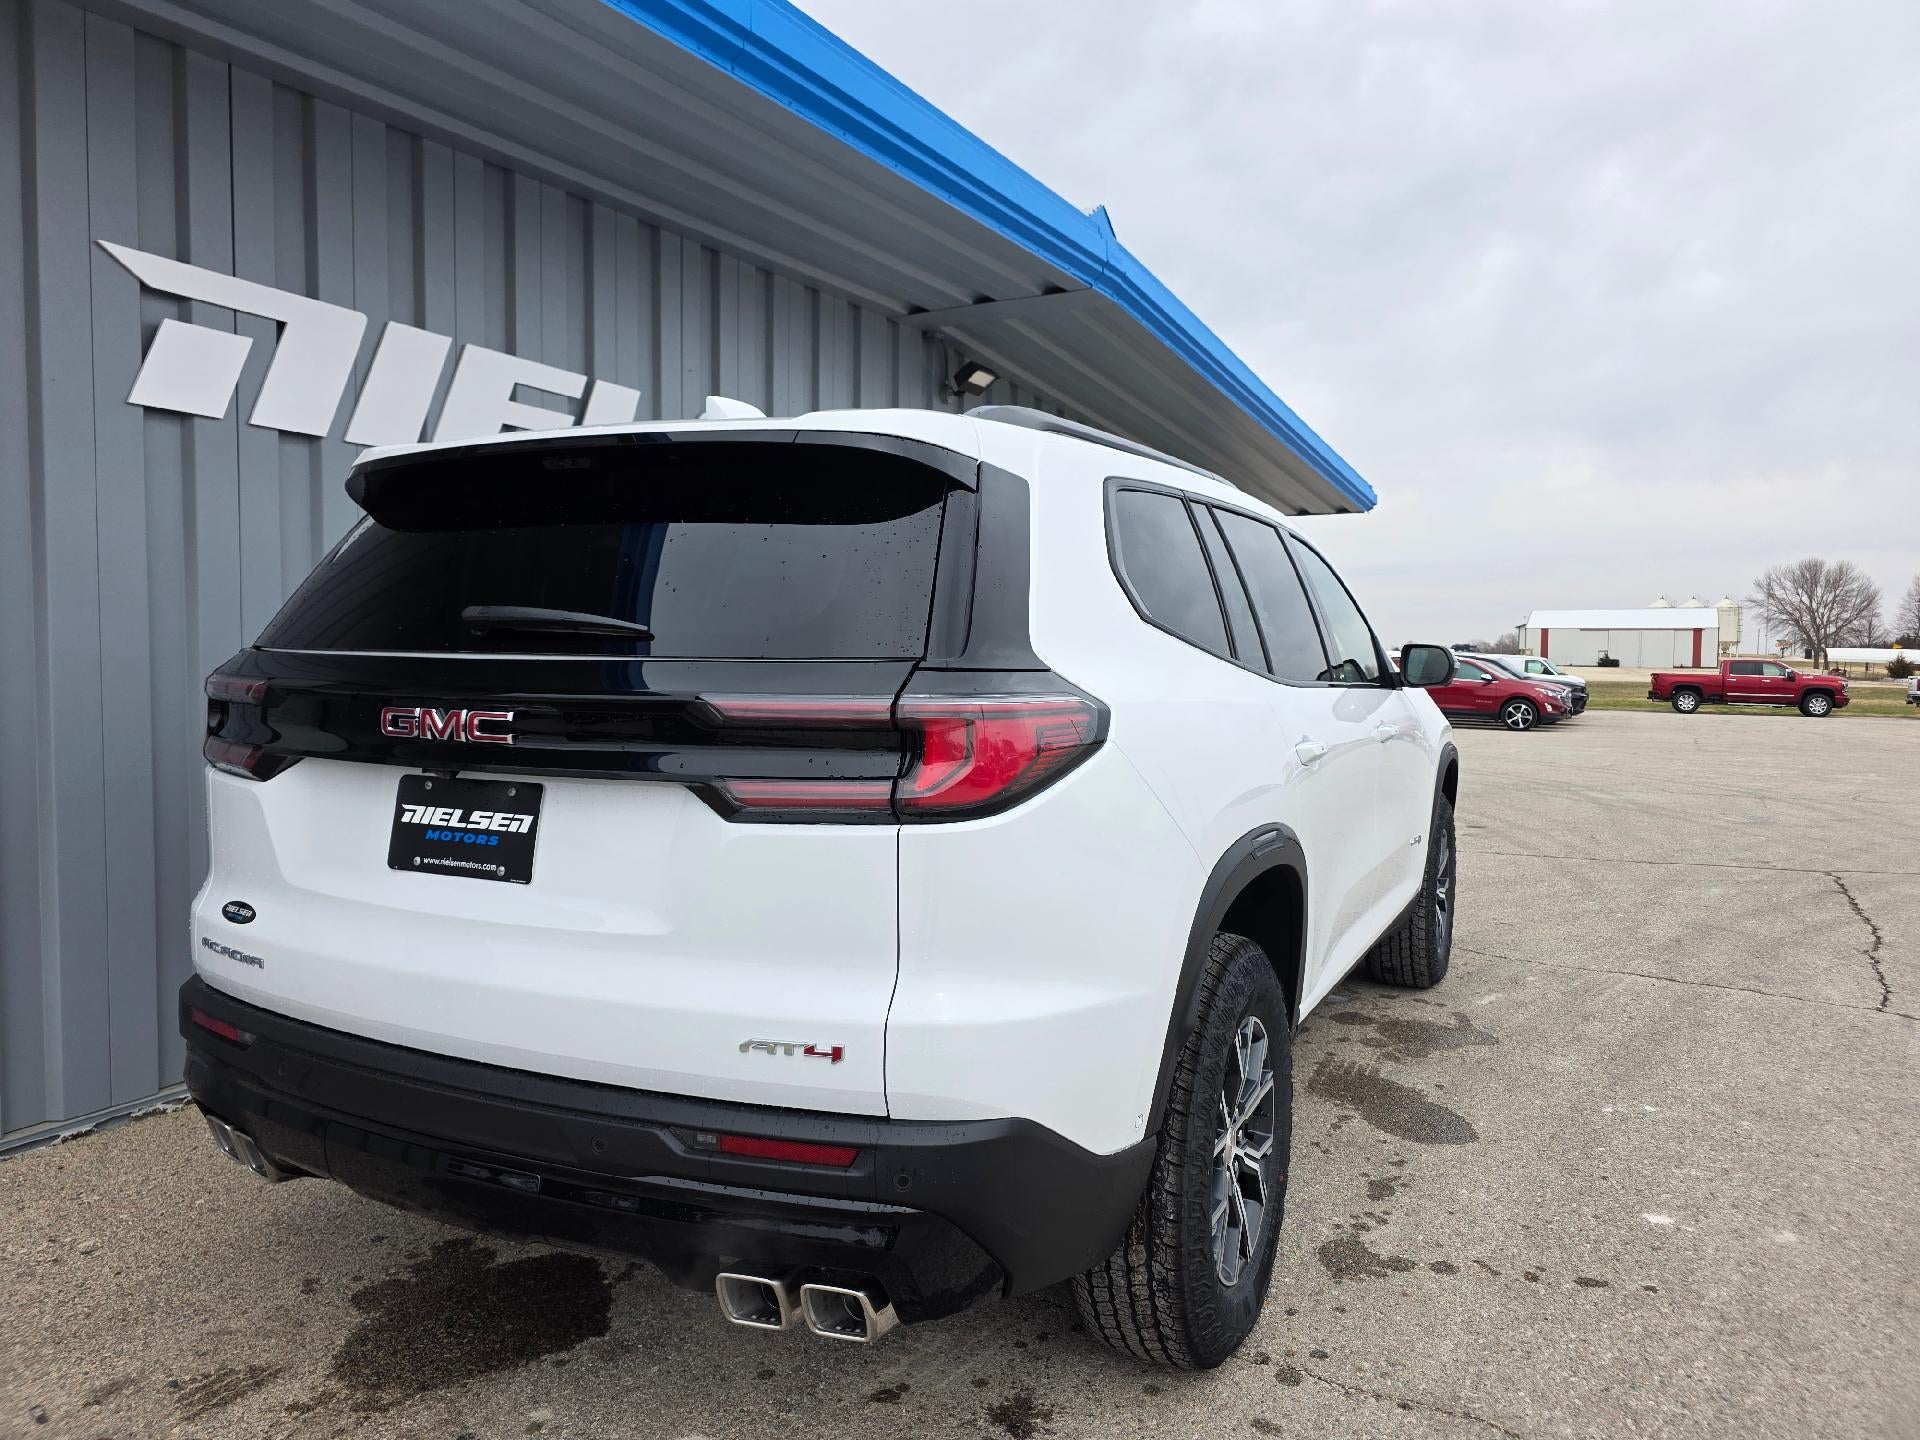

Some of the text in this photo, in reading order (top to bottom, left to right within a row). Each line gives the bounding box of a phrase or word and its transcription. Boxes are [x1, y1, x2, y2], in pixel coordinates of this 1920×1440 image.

[381, 706, 514, 744] GMC
[401, 803, 535, 834] NIELSEN
[425, 828, 500, 846] MOTORS
[423, 857, 497, 871] www.nielsenmotors.com
[739, 1038, 845, 1064] AT4
